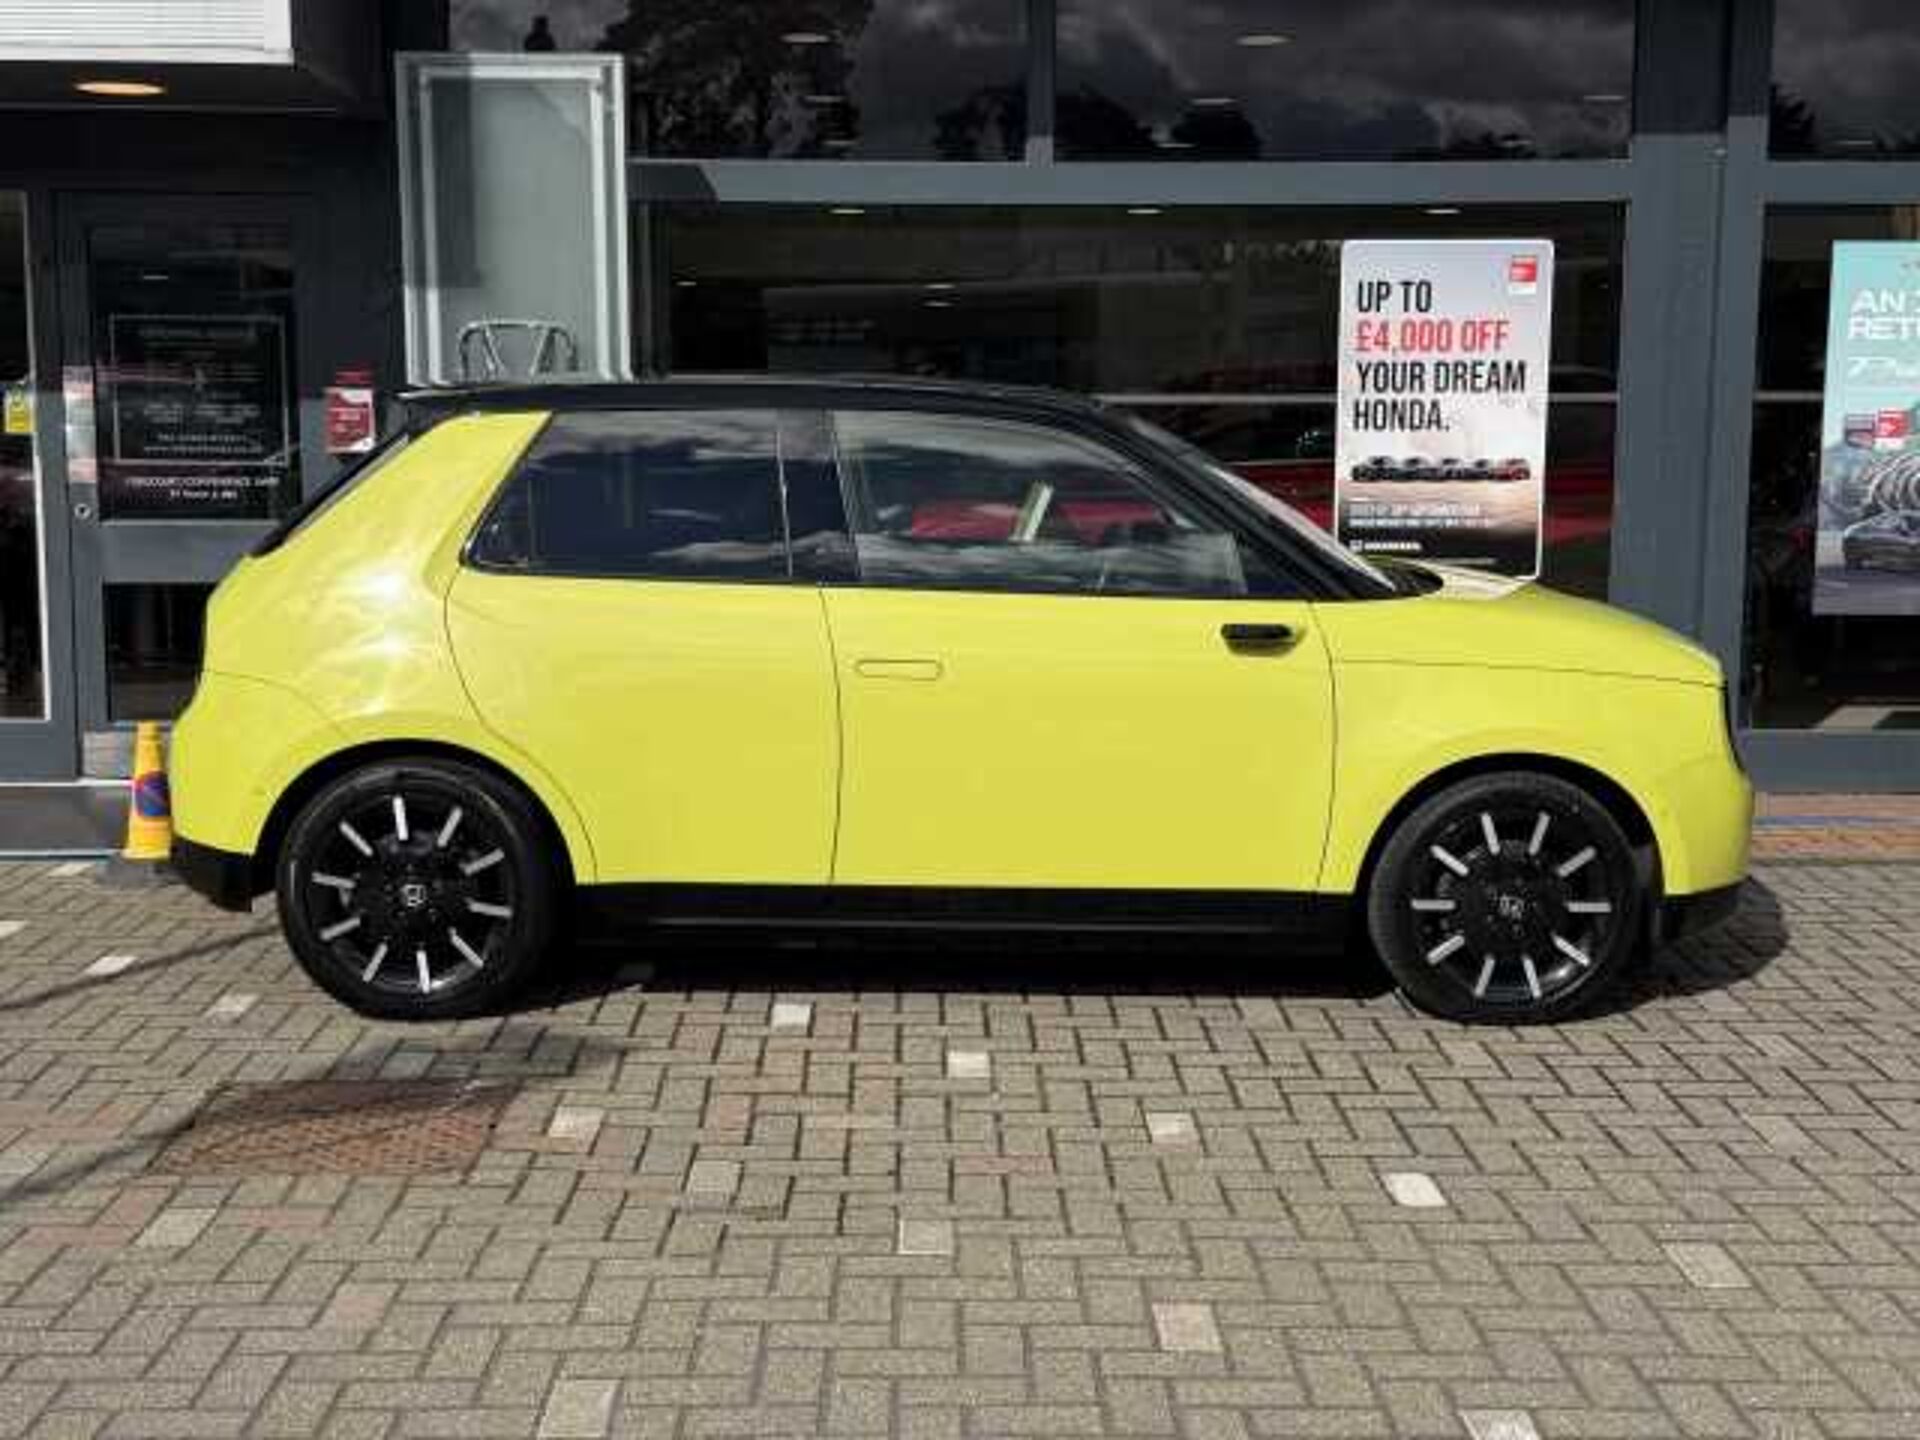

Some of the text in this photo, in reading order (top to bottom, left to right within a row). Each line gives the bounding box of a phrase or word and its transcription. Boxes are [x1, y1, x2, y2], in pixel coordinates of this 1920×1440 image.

[1357, 279, 1432, 313] UP TO
[1460, 320, 1510, 351] OFF
[1356, 361, 1527, 394] YOUR DREAM
[1353, 400, 1450, 432] HONDA.
